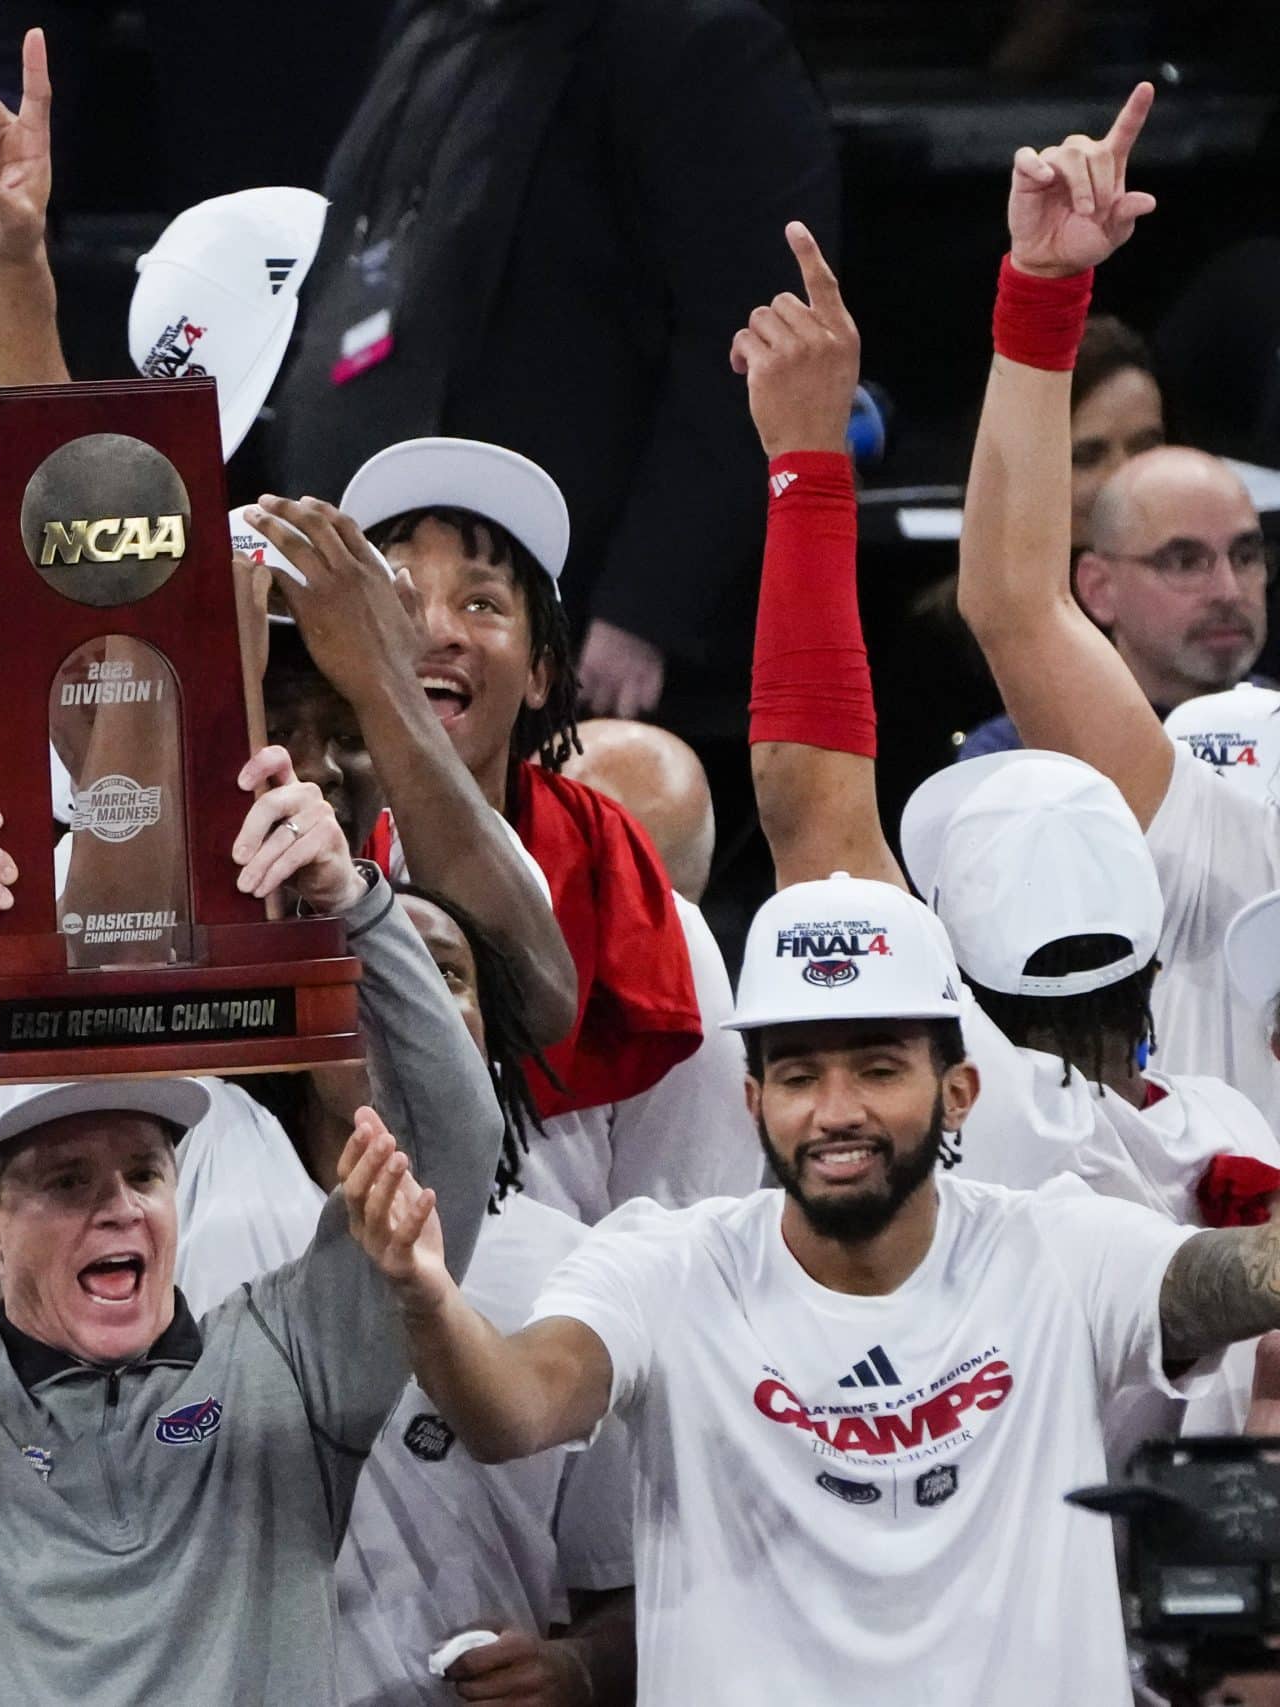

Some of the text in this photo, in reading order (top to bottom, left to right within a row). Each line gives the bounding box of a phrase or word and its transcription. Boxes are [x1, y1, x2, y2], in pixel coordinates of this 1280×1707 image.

[184, 323, 203, 347] 4
[40, 514, 186, 566] NCAA
[88, 661, 134, 680] 2023
[61, 680, 165, 706] DIVISION I
[1237, 746, 1258, 766] 4
[91, 792, 138, 808] MARCH
[96, 805, 159, 822] MADNESS
[86, 911, 178, 931] BASKETBALL
[84, 929, 163, 944] CHAMPIONSHIP
[778, 927, 888, 938] EAST REGIONAL CHAMPS
[776, 934, 890, 957] FINAL 4
[11, 999, 276, 1040] EAST REGIONAL CHAMPION
[828, 1402, 880, 1415] MEN'S
[885, 1387, 925, 1410] EAST
[929, 1345, 1001, 1393] REGIONAL
